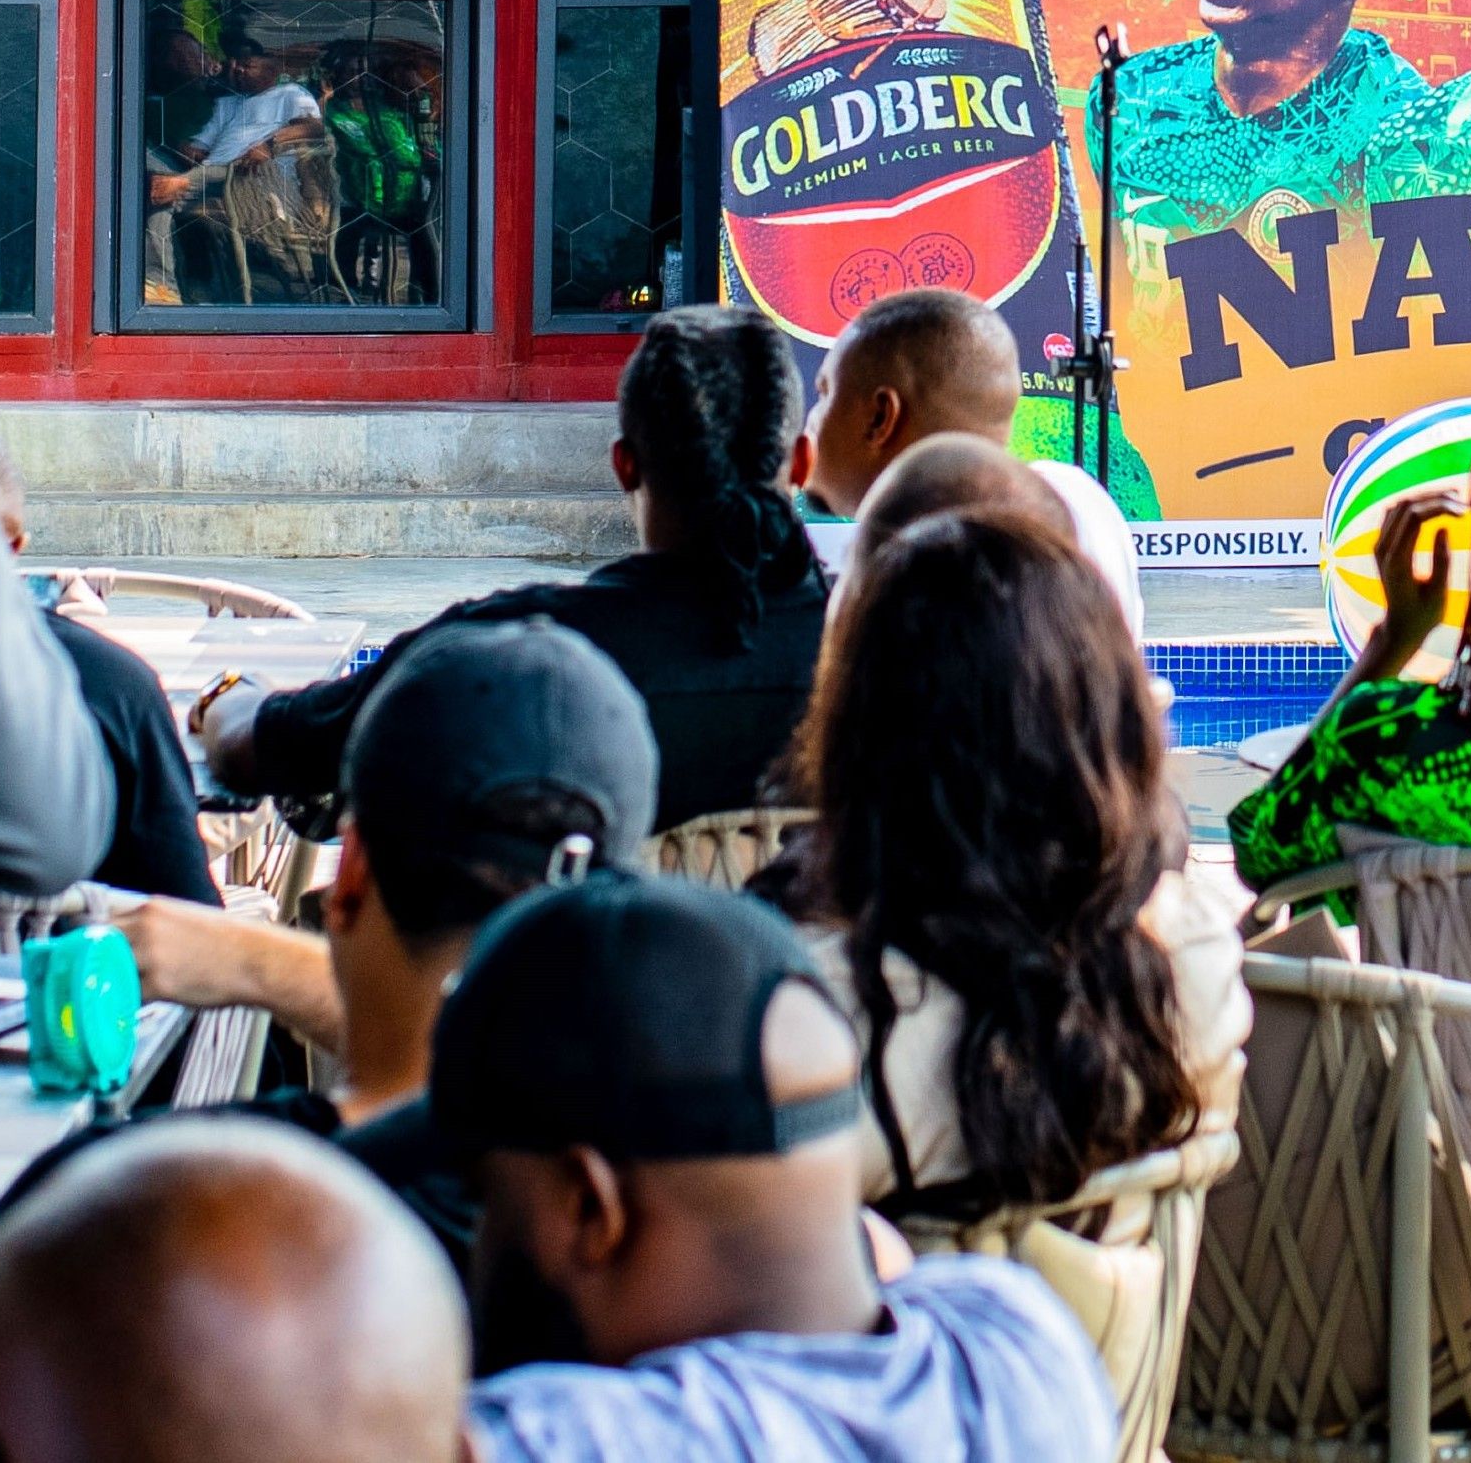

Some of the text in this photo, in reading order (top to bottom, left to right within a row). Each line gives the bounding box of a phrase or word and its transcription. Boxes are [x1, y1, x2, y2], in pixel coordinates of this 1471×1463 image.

[731, 74, 1035, 197] GOLDBERG
[783, 139, 996, 199] PREMIUM LAGER BEER
[1021, 371, 1055, 390] 5.0%
